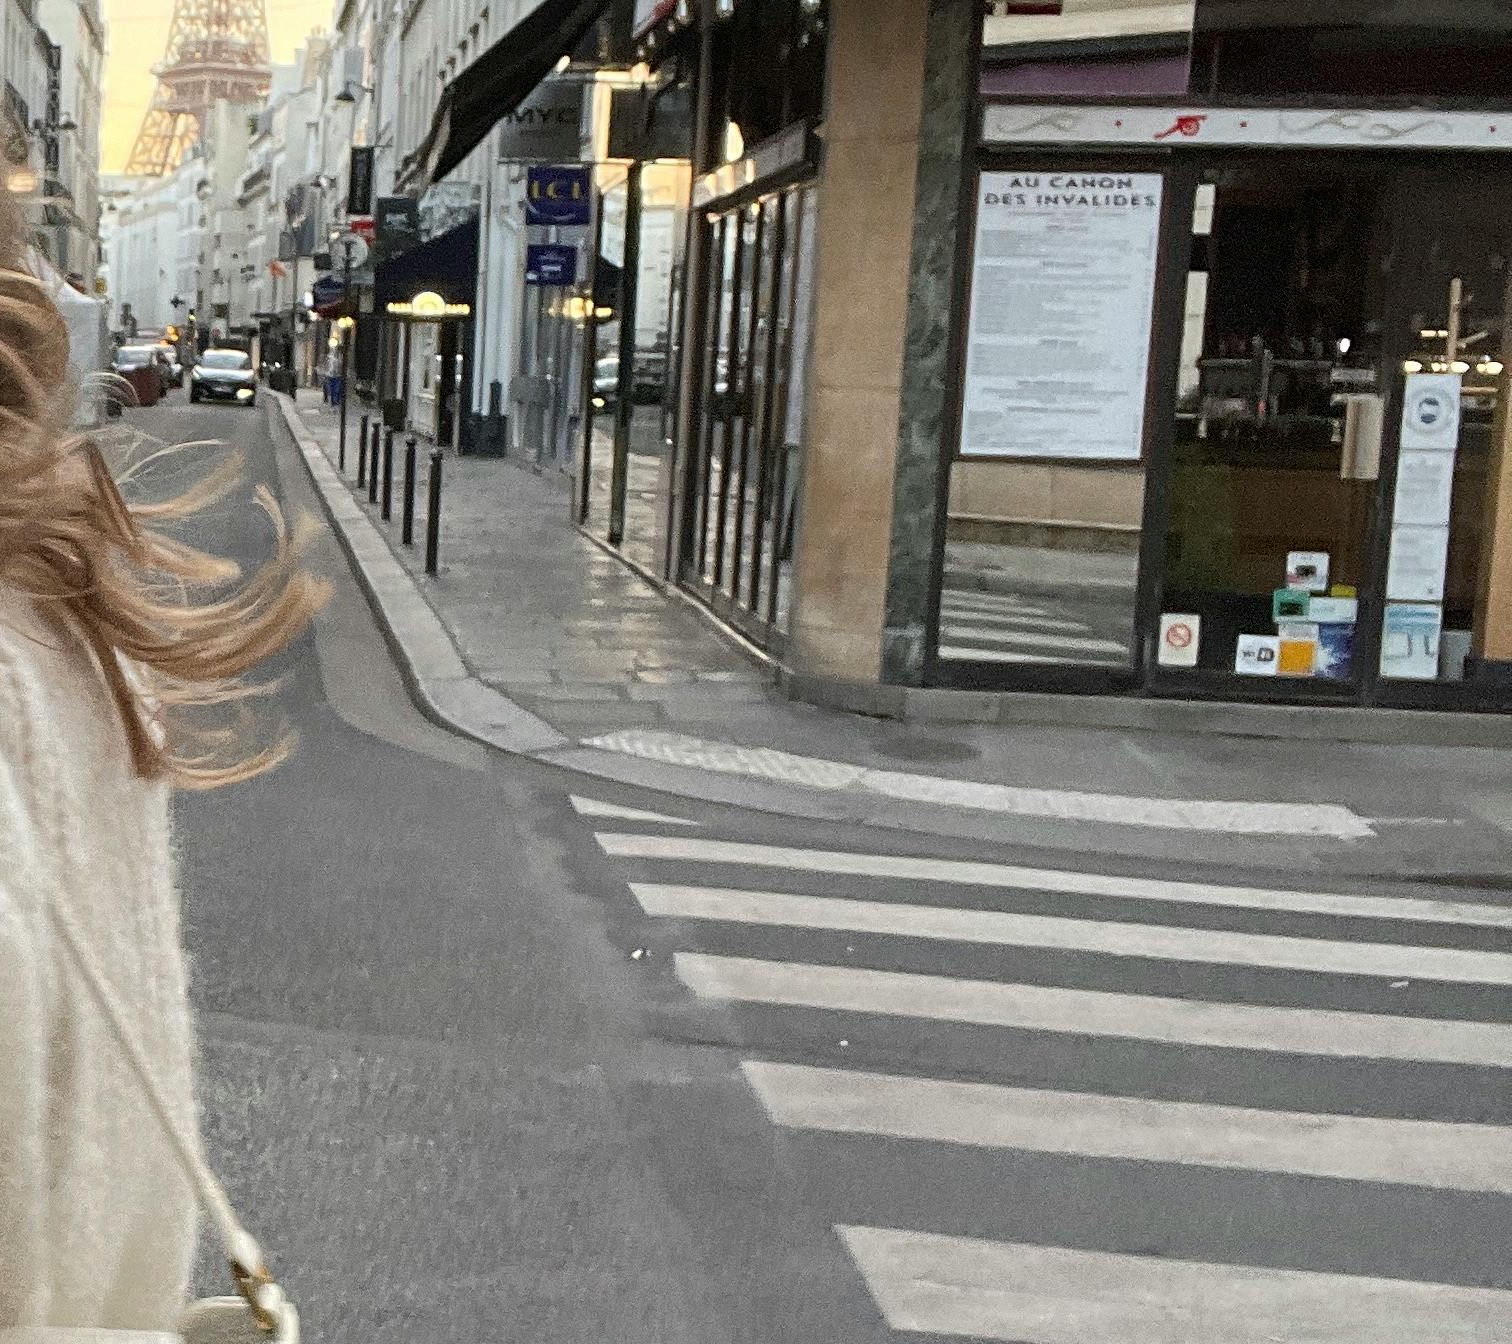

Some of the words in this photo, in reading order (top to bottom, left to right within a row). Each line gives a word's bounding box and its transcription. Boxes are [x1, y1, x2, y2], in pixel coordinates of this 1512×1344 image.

[1009, 176, 1039, 189] AU
[1048, 176, 1133, 189] CANON
[984, 192, 1026, 206] DES
[1036, 193, 1157, 207] INVALIDES
